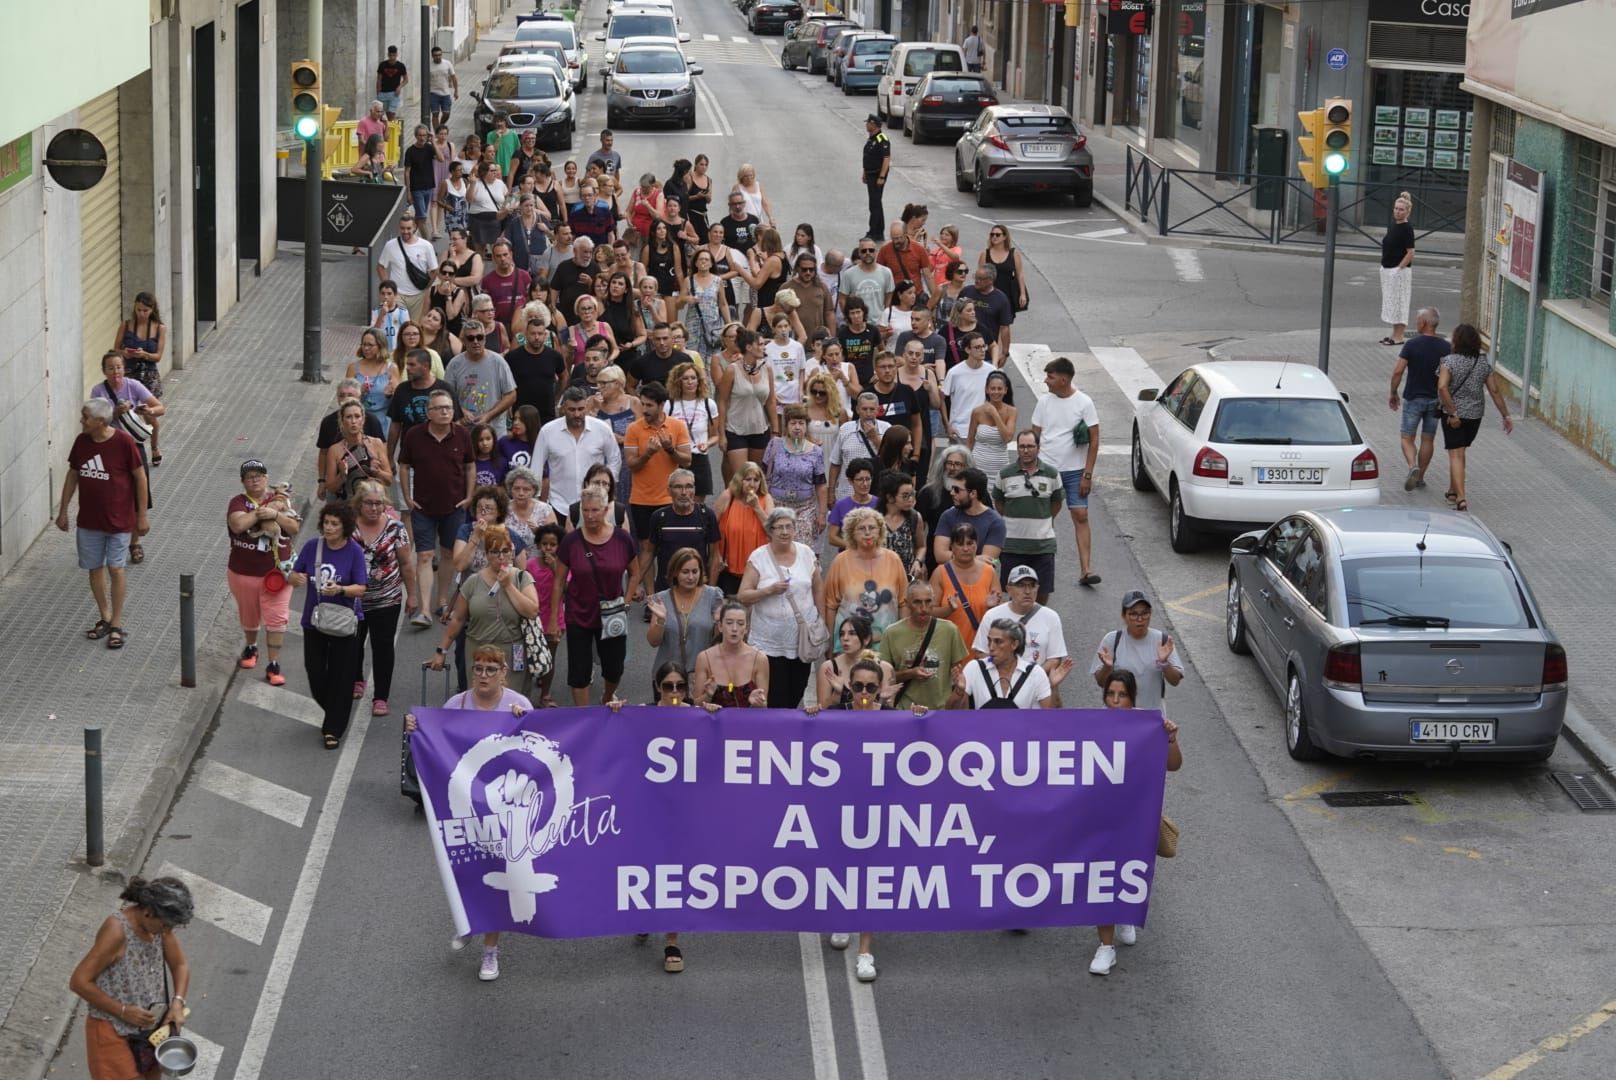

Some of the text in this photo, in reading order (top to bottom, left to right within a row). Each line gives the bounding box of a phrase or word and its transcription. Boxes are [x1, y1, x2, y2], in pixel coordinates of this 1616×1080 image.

[385, 326, 396, 336] 10
[80, 468, 110, 480] adidas
[1267, 469, 1320, 481] 9301 CJC
[1422, 724, 1490, 738] 4110 CRV
[645, 737, 1126, 791] SI ENS TOQUEN
[773, 803, 997, 854] A UNA,
[617, 859, 1148, 911] RESPONEM TOTES
